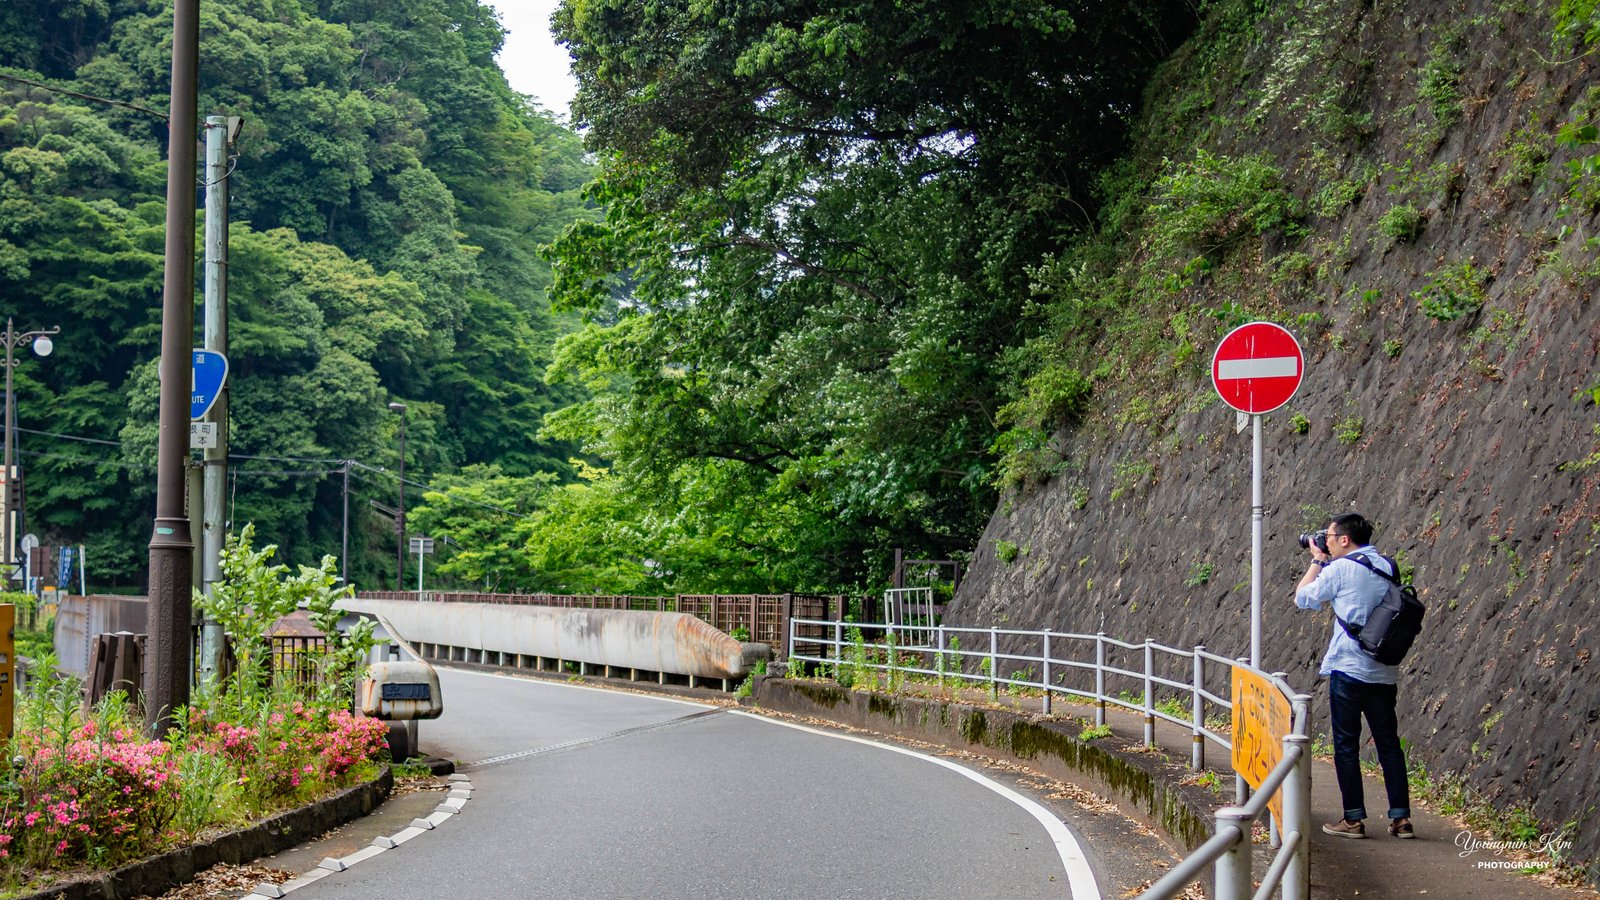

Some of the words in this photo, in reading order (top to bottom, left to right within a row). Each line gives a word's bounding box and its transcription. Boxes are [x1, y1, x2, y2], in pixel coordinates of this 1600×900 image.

[196, 353, 205, 364] 道
[192, 395, 205, 404] UTE
[191, 424, 211, 434] 根町
